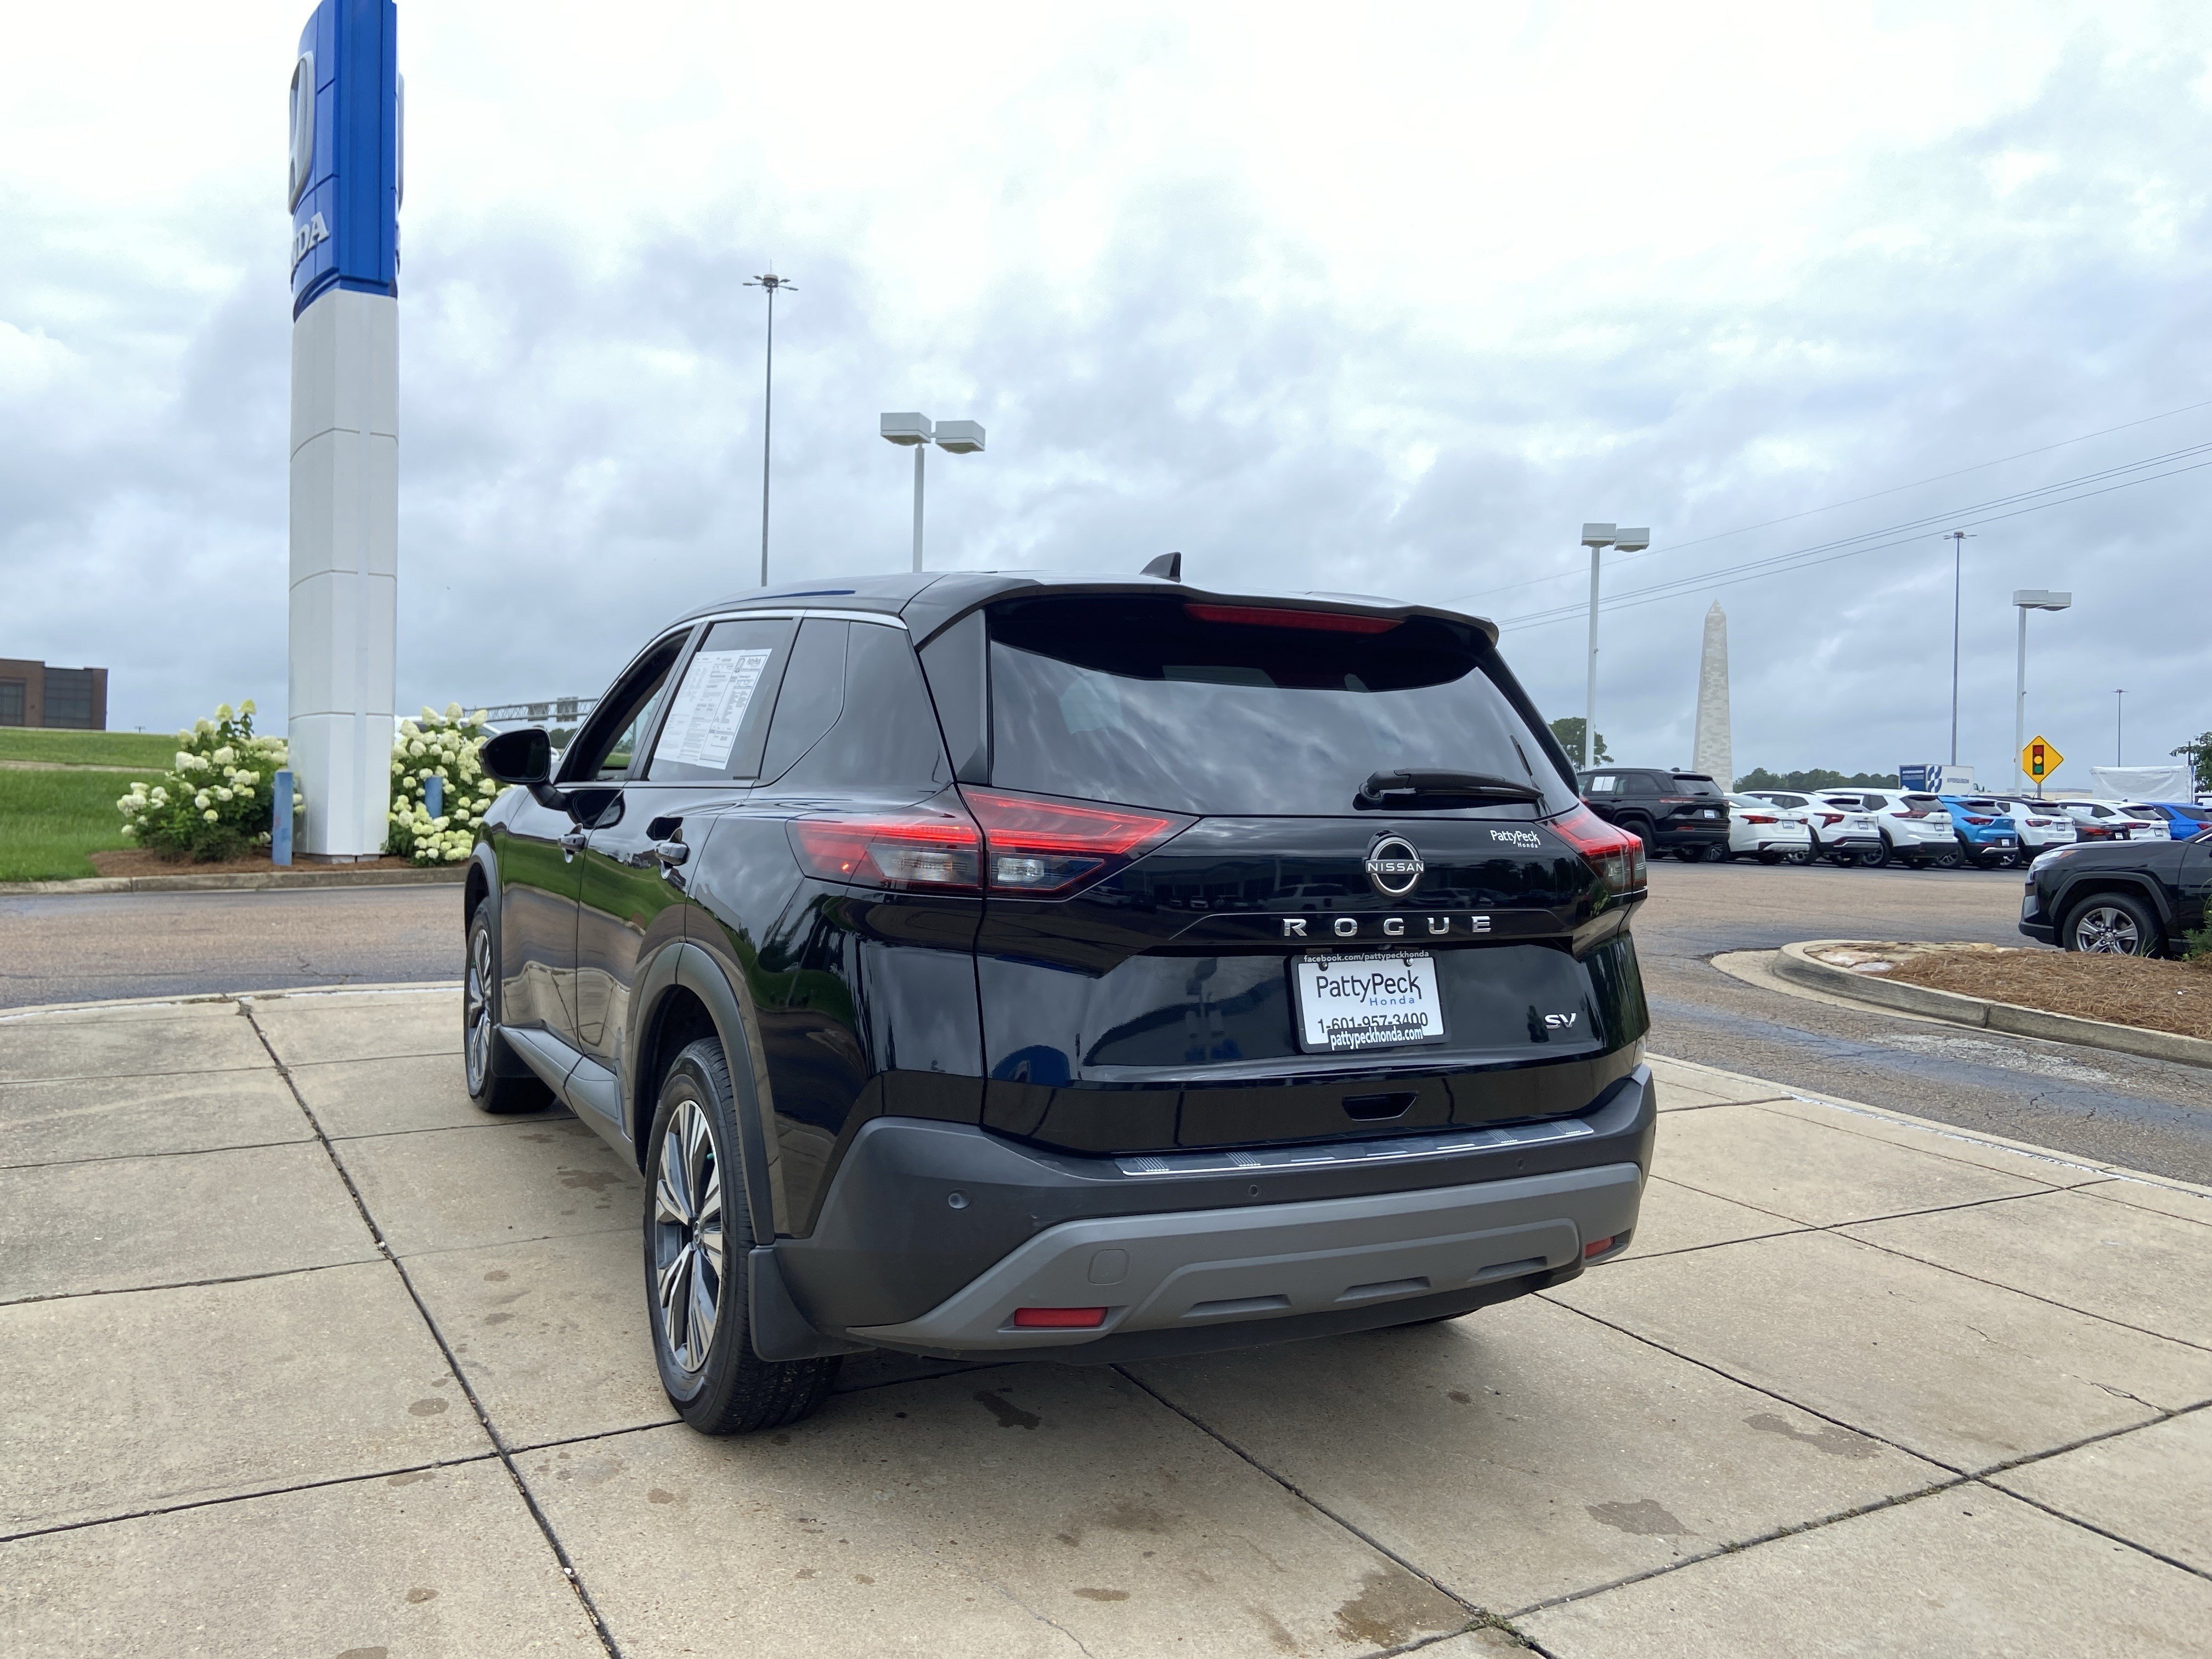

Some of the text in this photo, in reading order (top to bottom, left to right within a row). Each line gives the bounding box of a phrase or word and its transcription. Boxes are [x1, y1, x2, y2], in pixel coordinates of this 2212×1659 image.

[1489, 830, 1541, 845] PattyPeck
[1368, 862, 1424, 872] NISSAN
[1283, 916, 1491, 937] ROGUE
[1304, 950, 1429, 962] facebook.com/pattypeckhonda
[1316, 969, 1422, 1003] PattyPeck
[1369, 995, 1415, 1006] Honda
[1317, 1012, 1429, 1034] 1-601-957-3400
[1544, 1013, 1576, 1029] SV
[1329, 1025, 1424, 1051] pattypeckhonda.com
